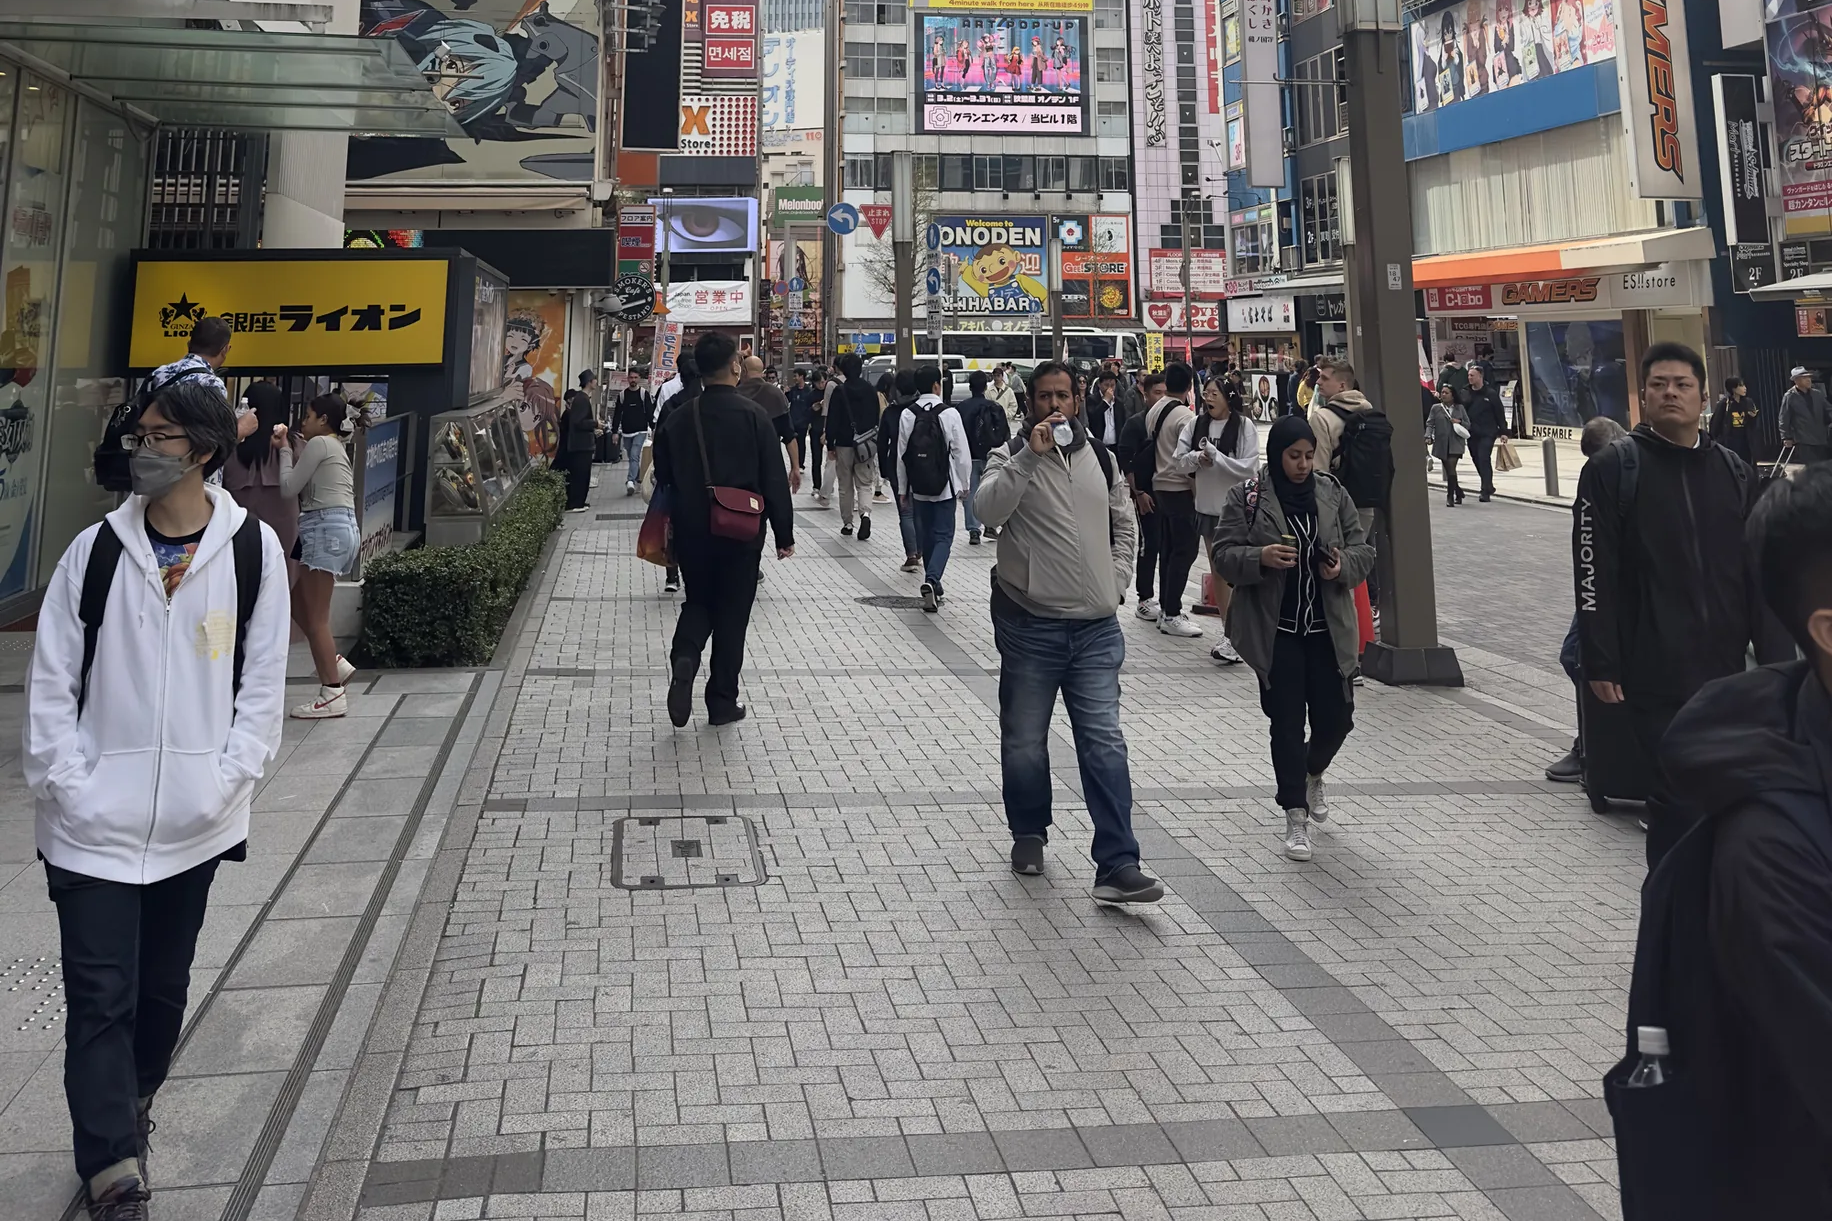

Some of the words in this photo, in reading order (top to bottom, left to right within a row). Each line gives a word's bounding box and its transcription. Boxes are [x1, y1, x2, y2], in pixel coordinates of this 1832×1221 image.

[949, 0, 979, 7] 4minute
[710, 10, 751, 31] 免税
[708, 46, 752, 63] 면세점
[953, 112, 1019, 123] グランエンタス
[1030, 113, 1078, 125] 当ビル1階
[680, 138, 711, 157] Store
[621, 214, 653, 223] フロア案内
[867, 208, 891, 217] 止まれ
[966, 219, 1002, 227] Welcome
[939, 227, 1042, 246] ONODEN
[1749, 266, 1763, 280] 2F
[694, 290, 744, 305] 営業中
[1501, 278, 1601, 306] GAMERS
[219, 304, 421, 333] 銀座ライオン
[1003, 320, 1030, 332] オノデ
[1531, 427, 1573, 440] ENSEMBLE
[1580, 497, 1597, 612] MAJORITY
